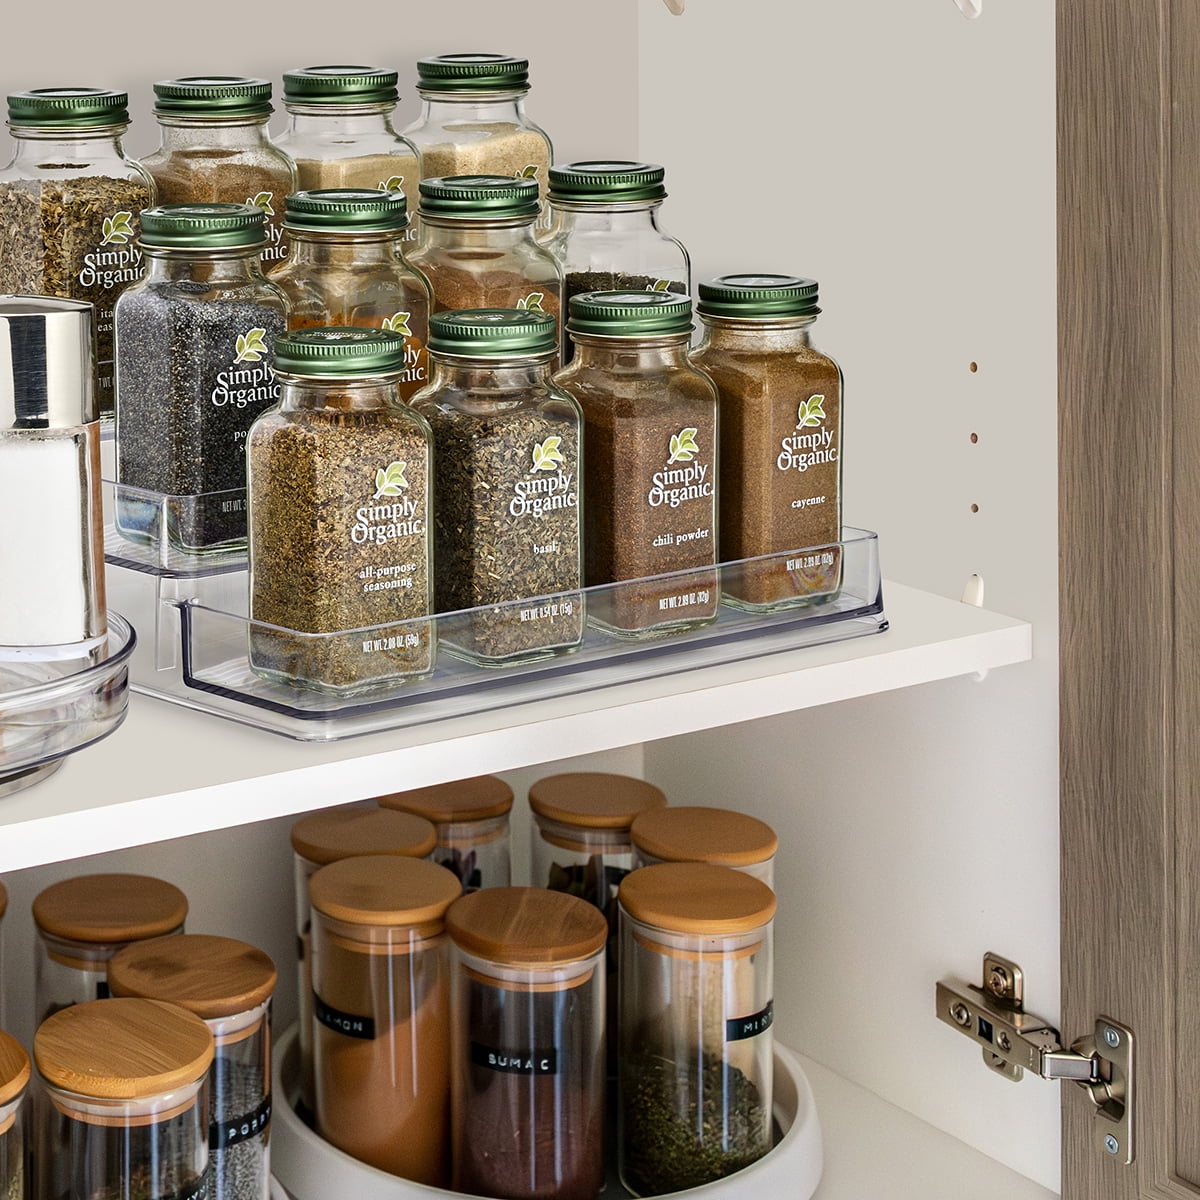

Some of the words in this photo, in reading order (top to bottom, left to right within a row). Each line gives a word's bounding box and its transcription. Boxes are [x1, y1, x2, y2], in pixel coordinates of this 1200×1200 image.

[84, 244, 143, 270] Simply
[216, 361, 276, 389] Simply
[211, 384, 282, 409] Organic
[782, 427, 834, 453] Simply
[514, 470, 572, 499] Simply
[652, 460, 708, 488] Simply
[222, 500, 232, 513] NET
[356, 498, 418, 526] Simply
[791, 495, 826, 509] cayenne
[652, 535, 673, 547] chili
[676, 528, 709, 546] powder
[533, 543, 557, 555] basil
[359, 562, 417, 579] all-purpose
[363, 576, 413, 592] seasoning
[488, 1053, 549, 1071] SUMAC
